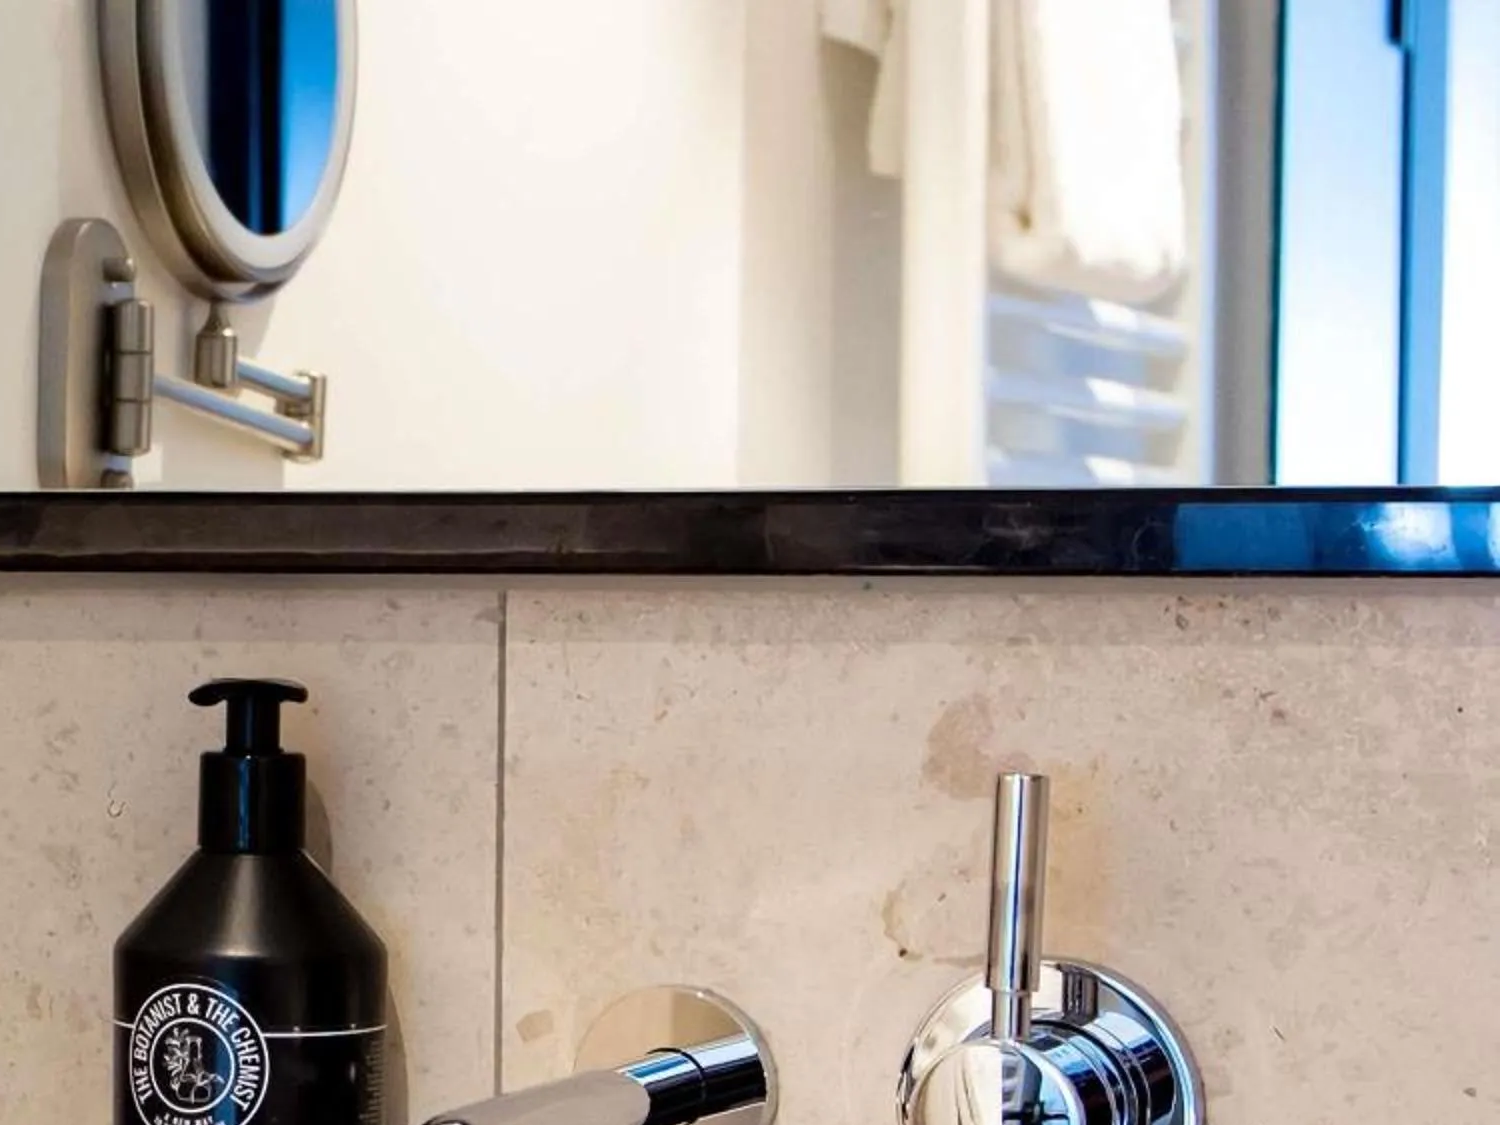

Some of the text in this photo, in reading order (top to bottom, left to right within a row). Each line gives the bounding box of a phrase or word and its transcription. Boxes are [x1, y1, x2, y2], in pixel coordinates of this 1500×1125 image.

[133, 992, 261, 1113] THE BOTANIST & THE CHEMIST
